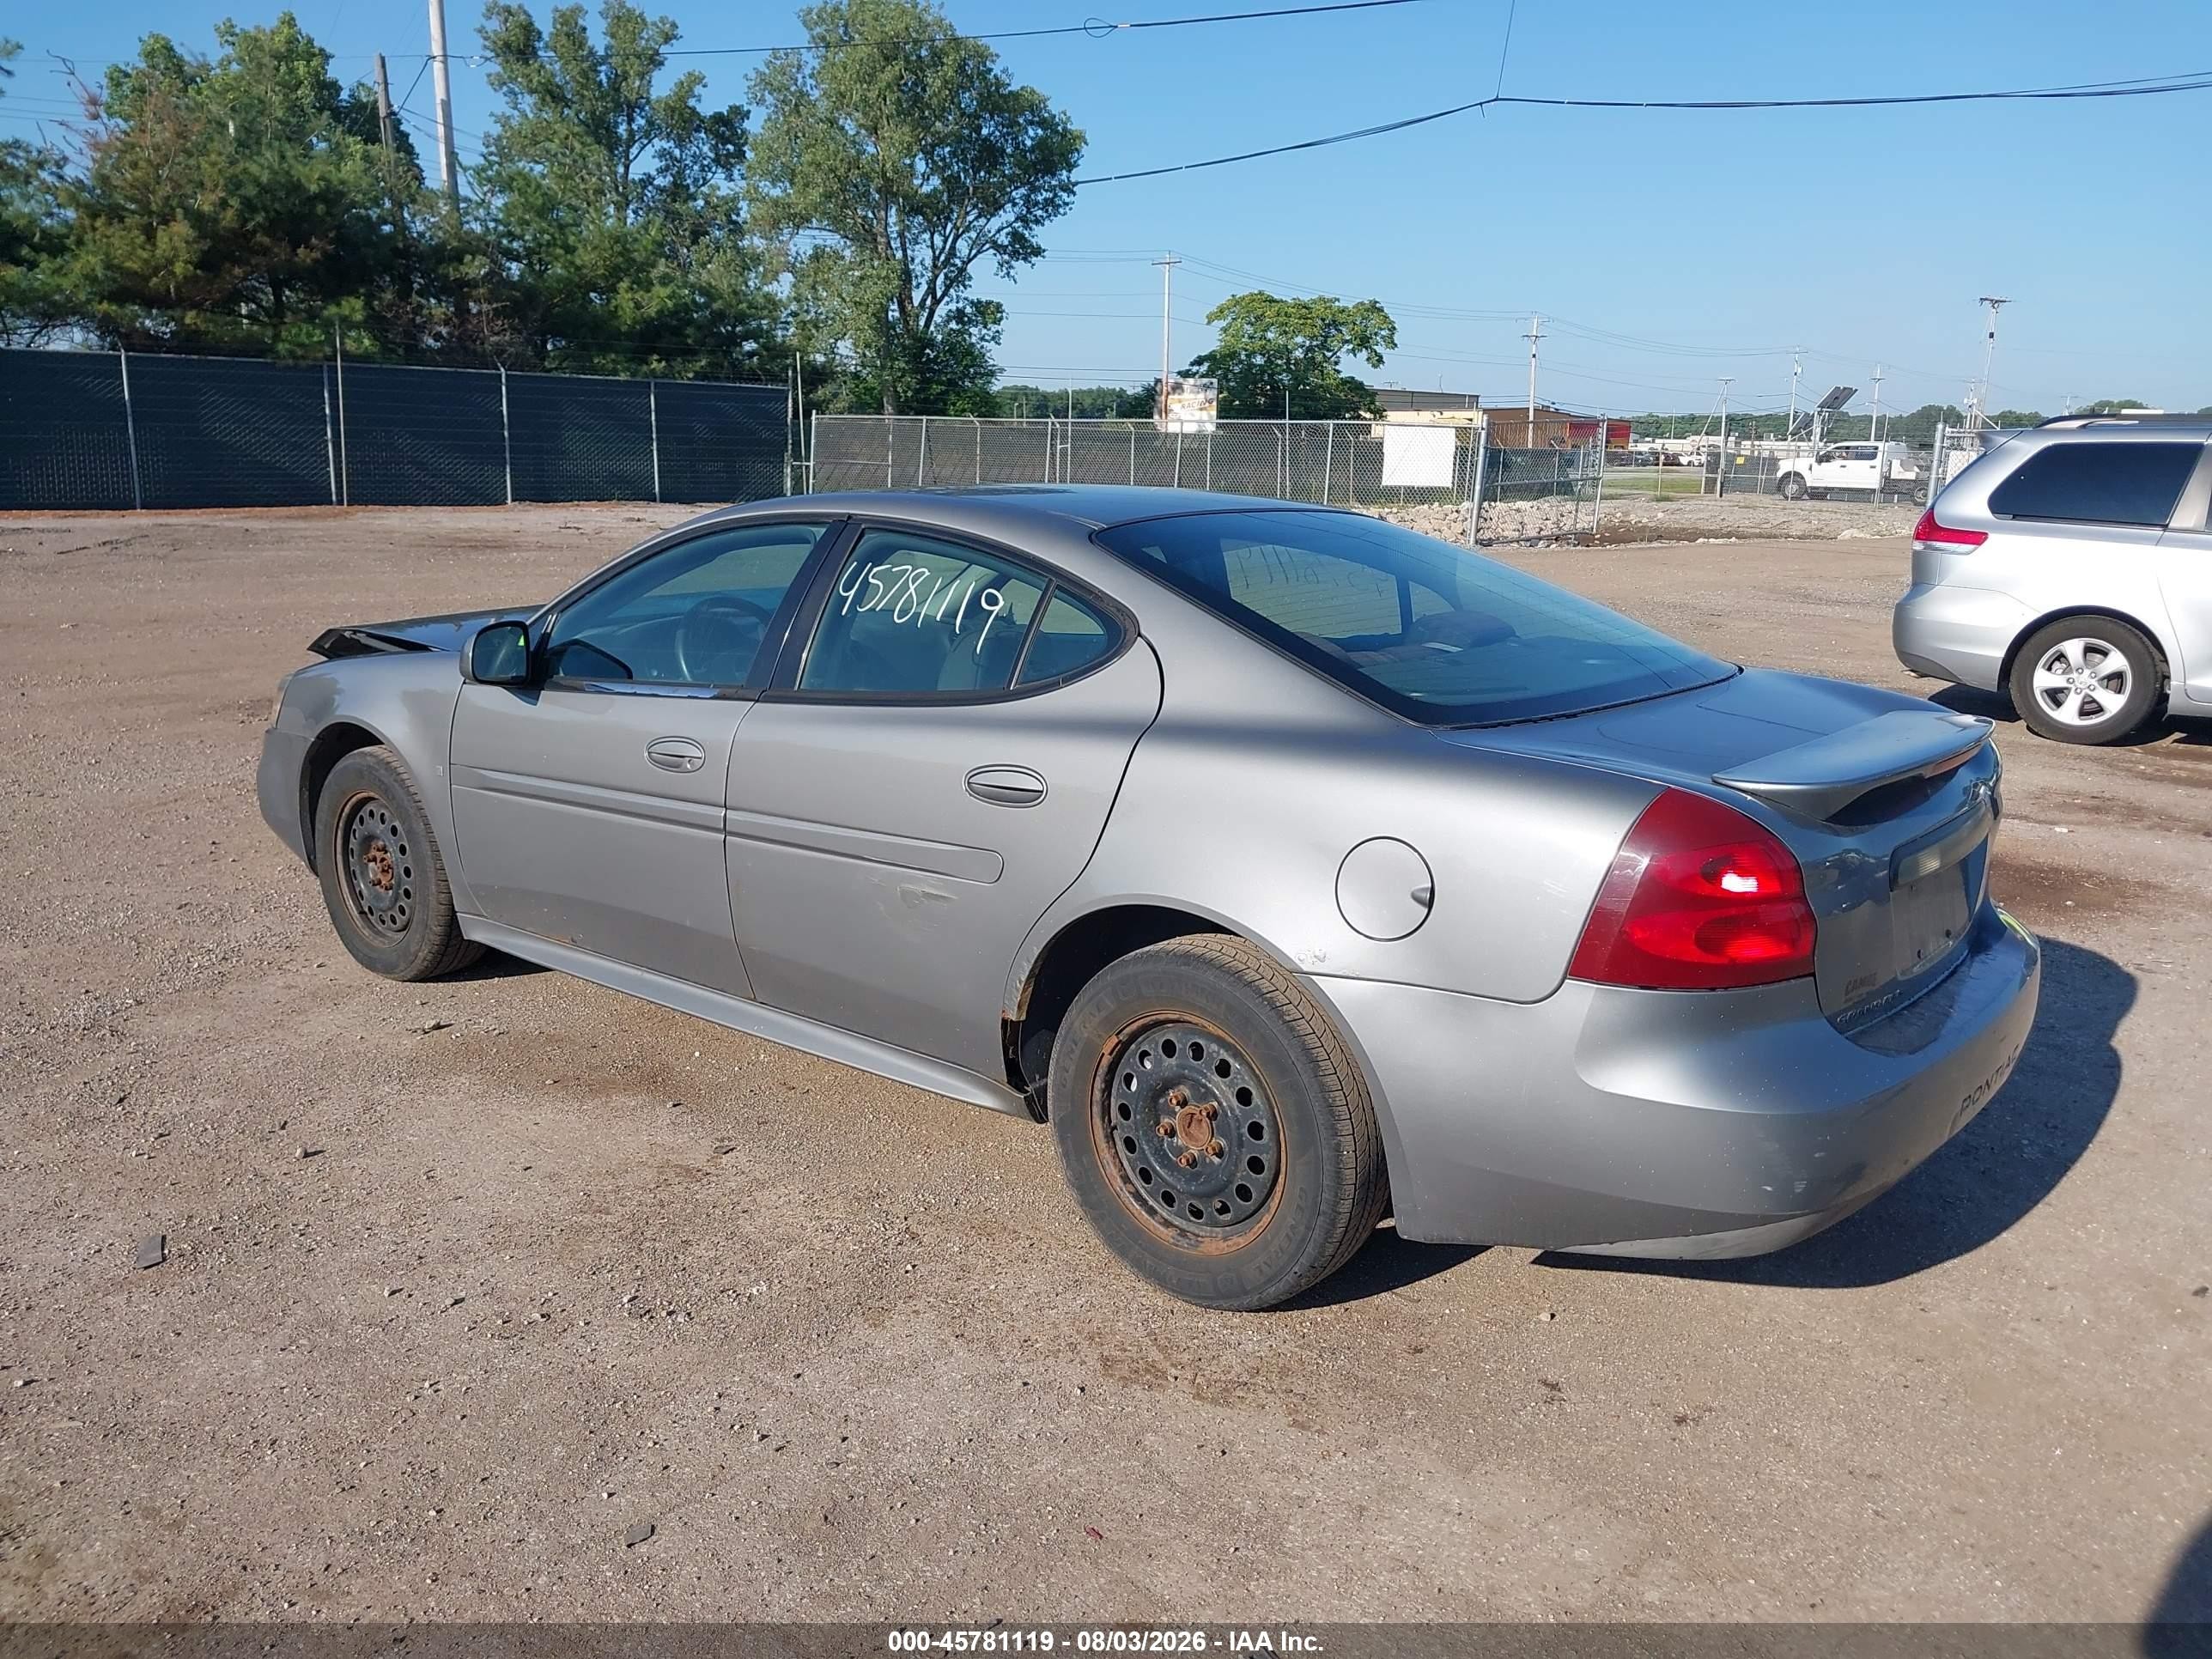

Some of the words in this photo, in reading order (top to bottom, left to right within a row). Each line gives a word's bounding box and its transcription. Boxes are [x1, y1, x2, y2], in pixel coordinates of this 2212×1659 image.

[1181, 399, 1215, 410] RACING
[839, 562, 1005, 654] 45781119
[1959, 1043, 2020, 1117] PONTIAC
[1255, 1186, 1306, 1274] GENERAL
